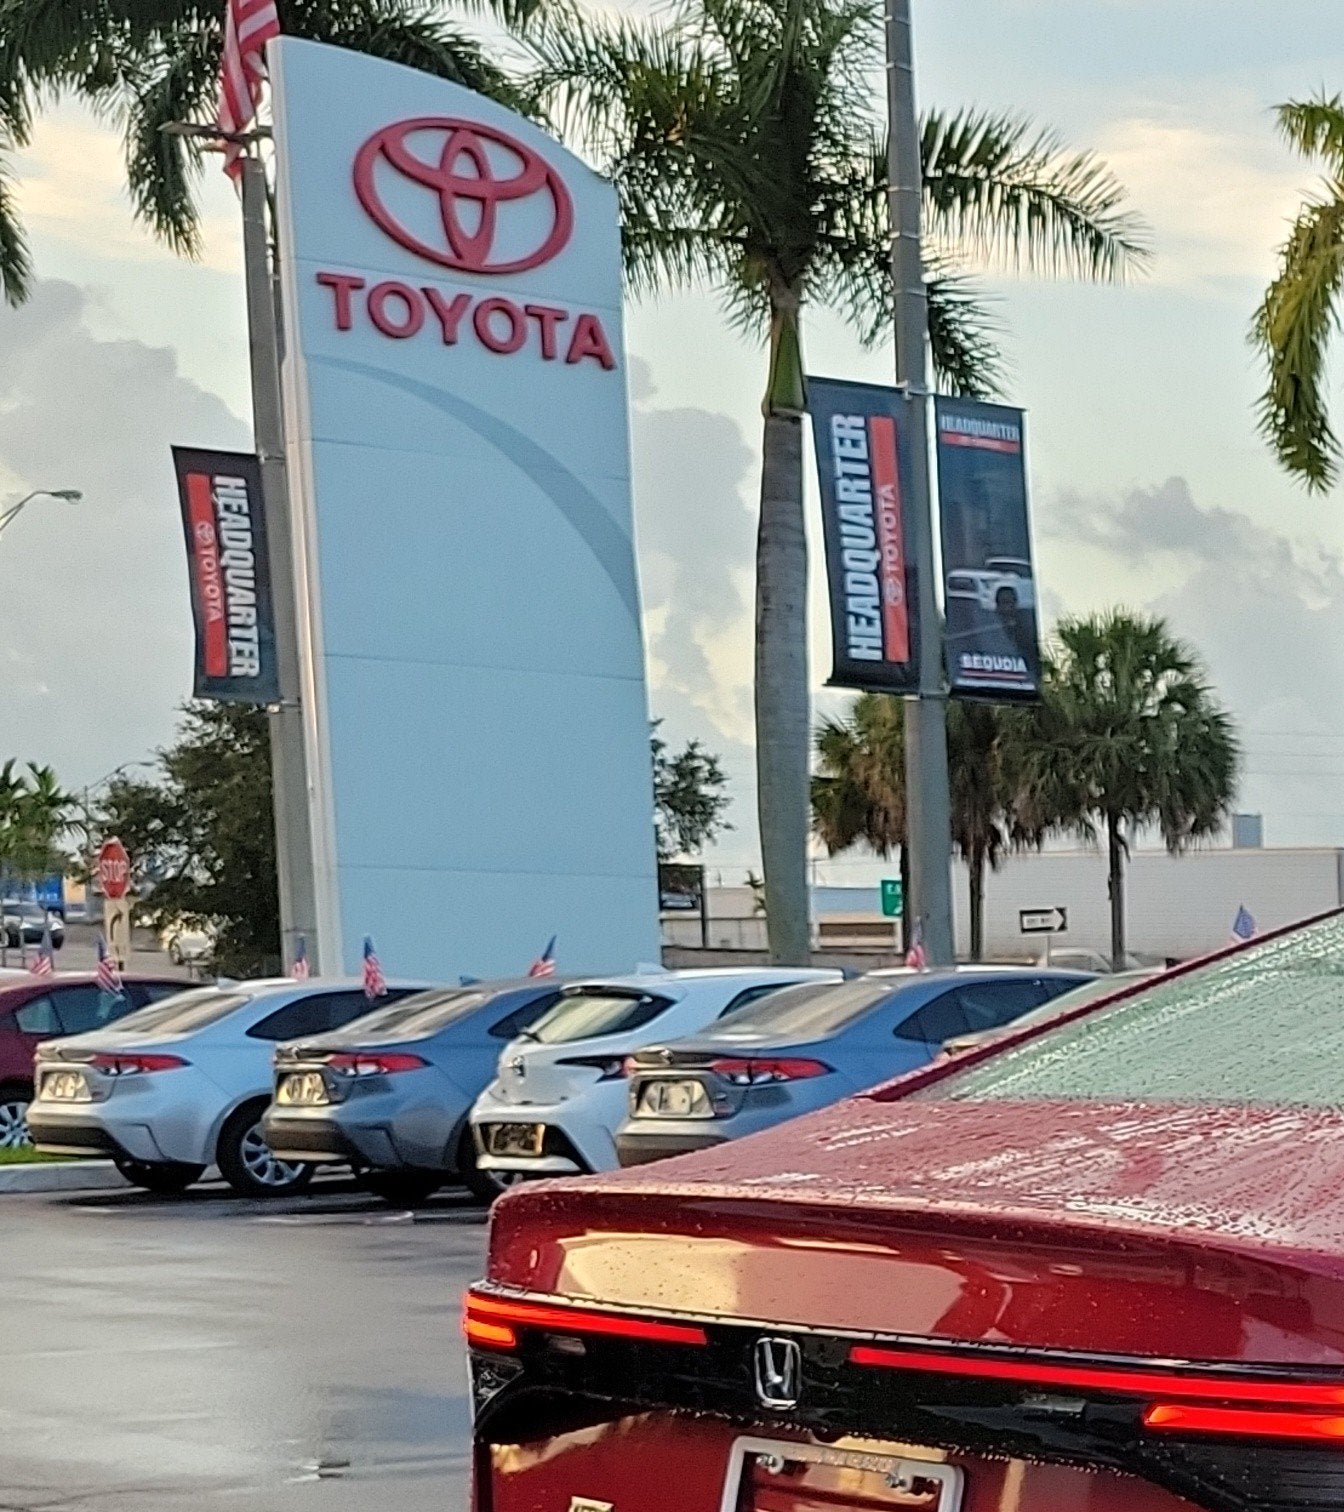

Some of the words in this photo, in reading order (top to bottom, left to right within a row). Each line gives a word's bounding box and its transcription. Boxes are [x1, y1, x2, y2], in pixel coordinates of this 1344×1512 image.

[316, 272, 617, 371] TOYOTA
[831, 414, 883, 661] HEADQUARTER
[876, 484, 901, 574] TOYOTA
[197, 550, 224, 622] TOYOTA
[212, 475, 260, 677] HEADQUARTER
[960, 653, 1028, 673] SEQUOIA
[101, 859, 127, 882] STOP
